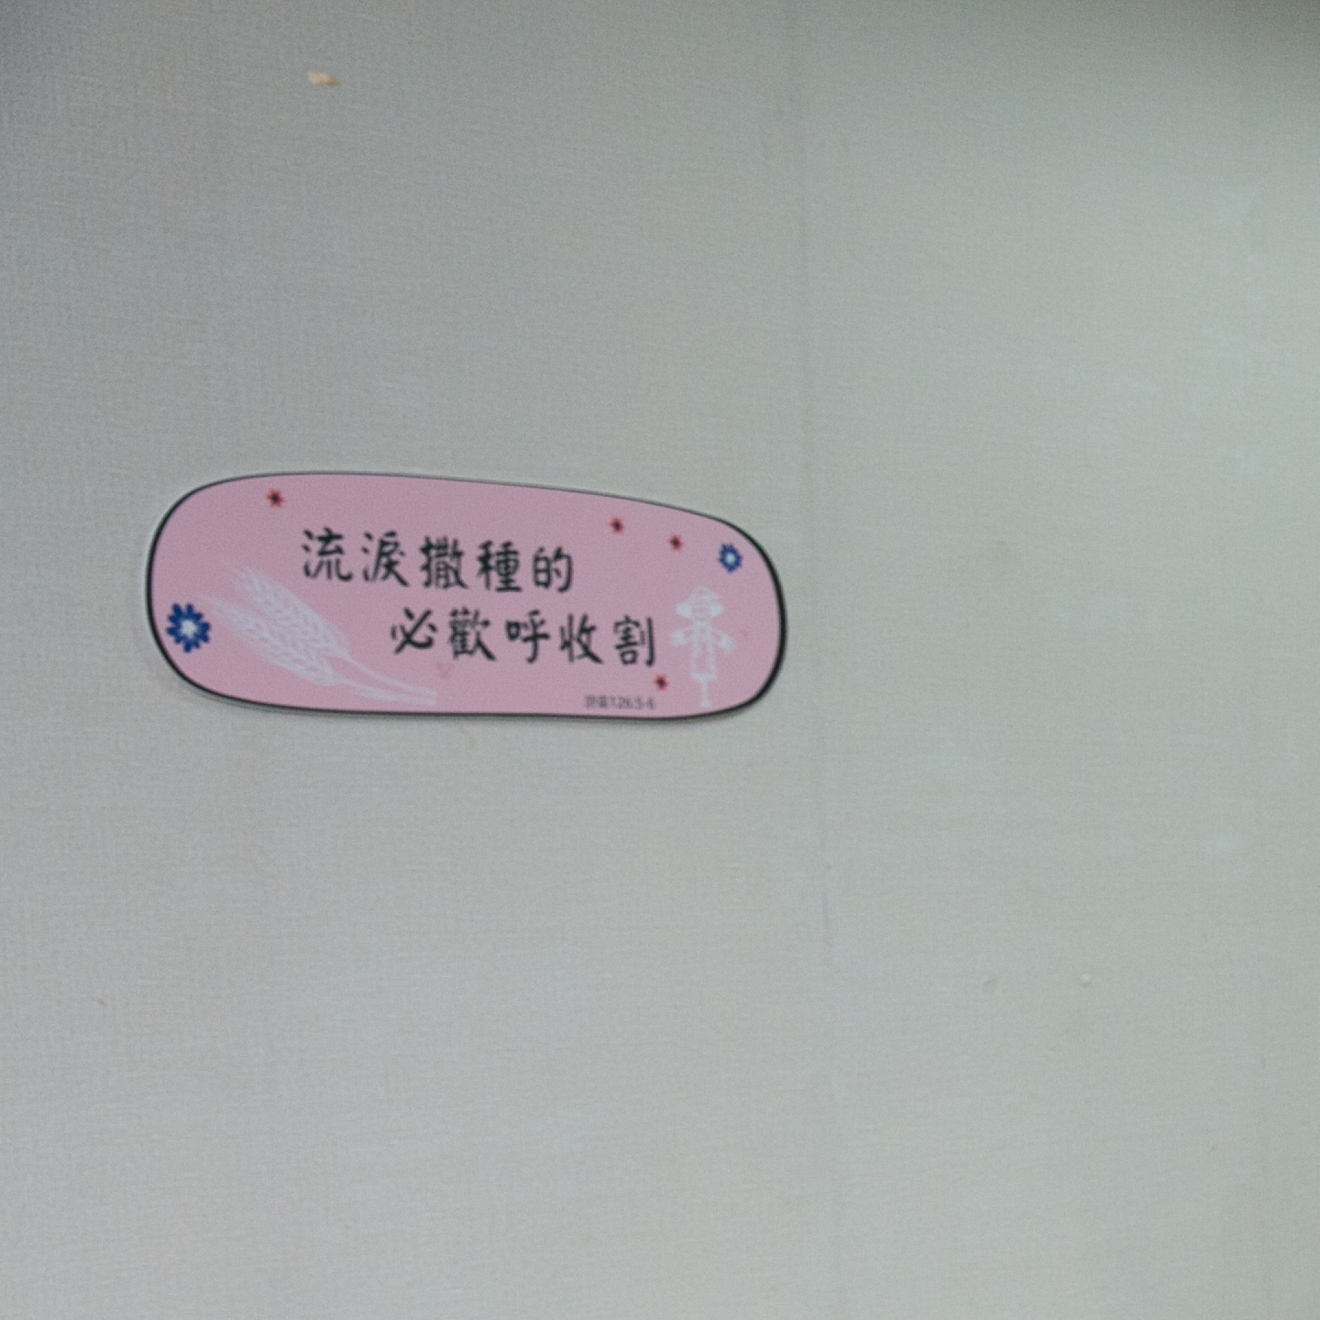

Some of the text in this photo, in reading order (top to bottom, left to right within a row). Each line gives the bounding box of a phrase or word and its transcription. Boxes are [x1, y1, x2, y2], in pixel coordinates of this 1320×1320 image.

[302, 527, 573, 593] 流淚撒種的
[390, 606, 655, 667] 必歡呼收割
